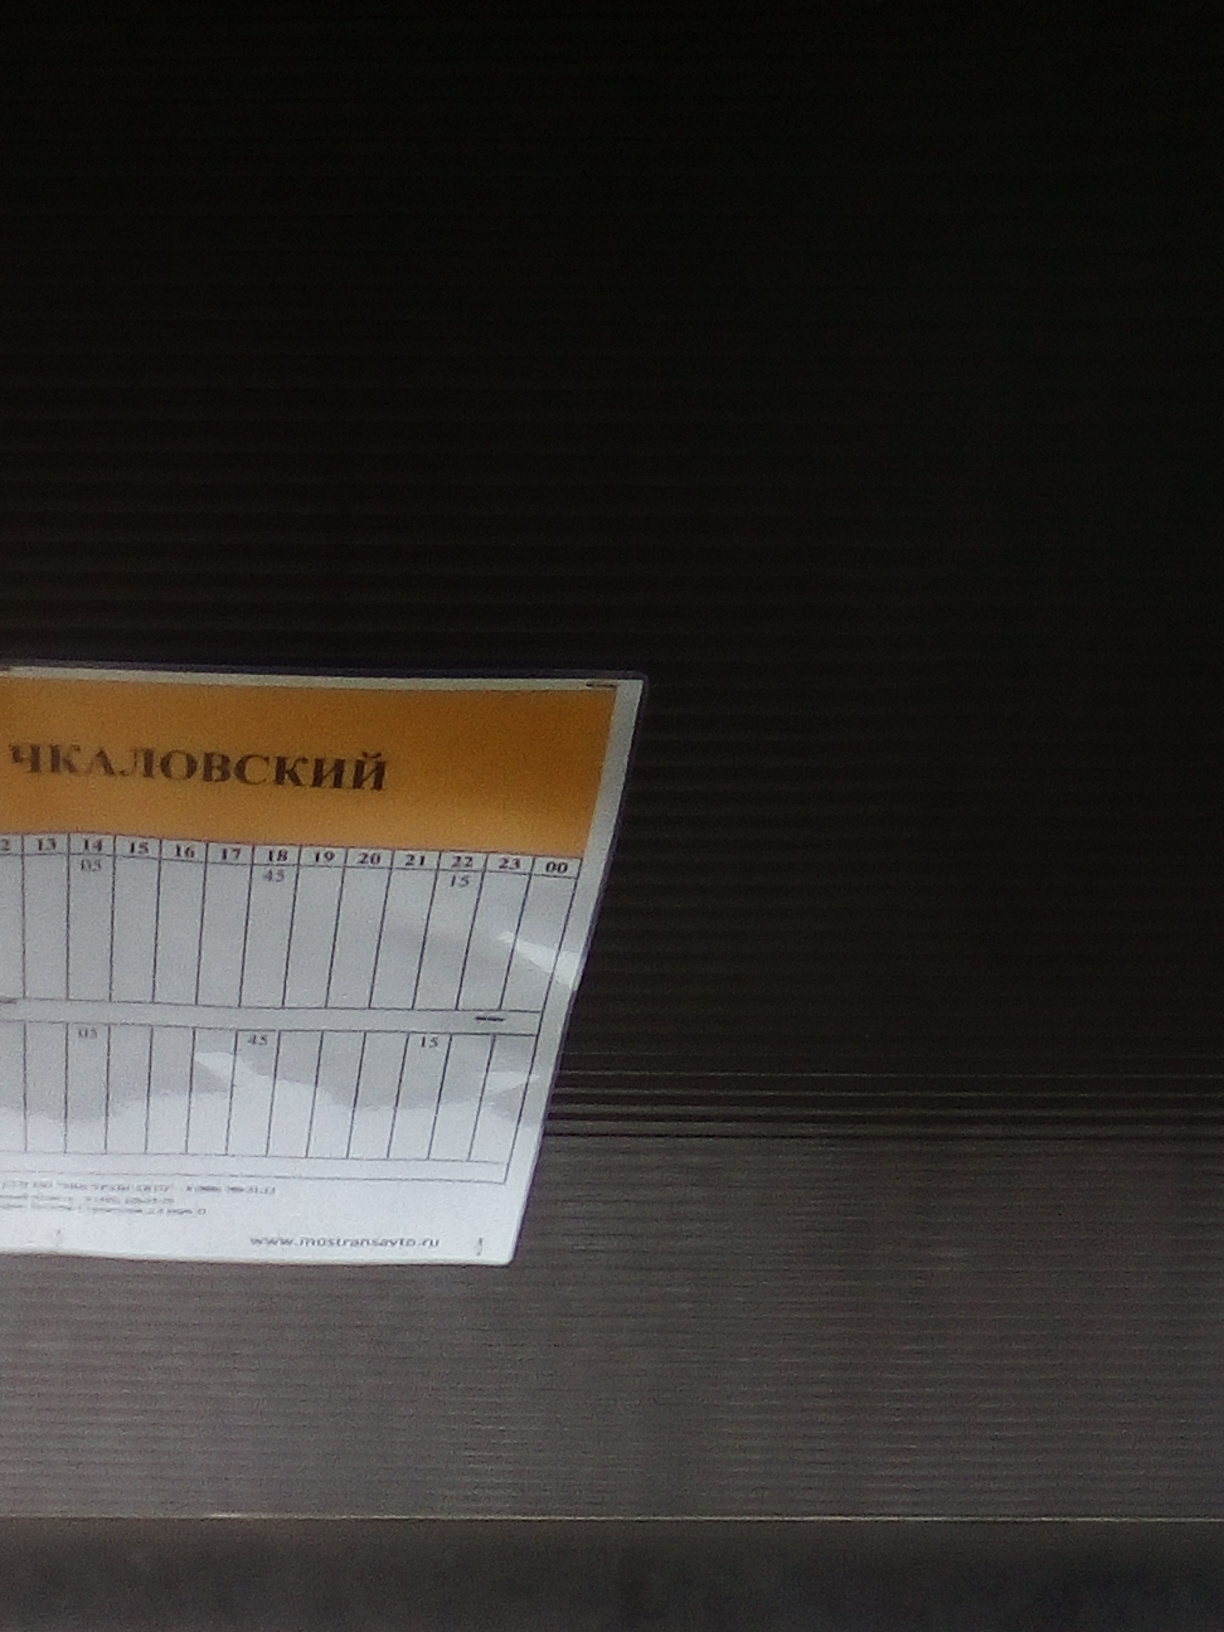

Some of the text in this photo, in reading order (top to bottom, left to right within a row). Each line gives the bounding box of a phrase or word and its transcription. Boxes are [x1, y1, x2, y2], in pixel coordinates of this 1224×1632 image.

[11, 743, 388, 793] ЧКАЛОВСКИЙ
[36, 837, 57, 851] 13
[82, 837, 103, 851] 14
[129, 841, 149, 854] 15
[175, 844, 196, 858] 16
[221, 847, 242, 860] 17
[267, 849, 288, 862] 18
[314, 851, 335, 863] 19
[357, 852, 381, 865] 20
[405, 853, 426, 866] 21
[452, 855, 473, 868] 22
[498, 857, 521, 870] 23
[545, 860, 568, 874] 00
[263, 869, 284, 882] 45
[449, 874, 470, 887] 15
[248, 1033, 269, 1045] 45
[421, 1036, 440, 1048] 15
[250, 1237, 440, 1249] www.mostransavto.ru
